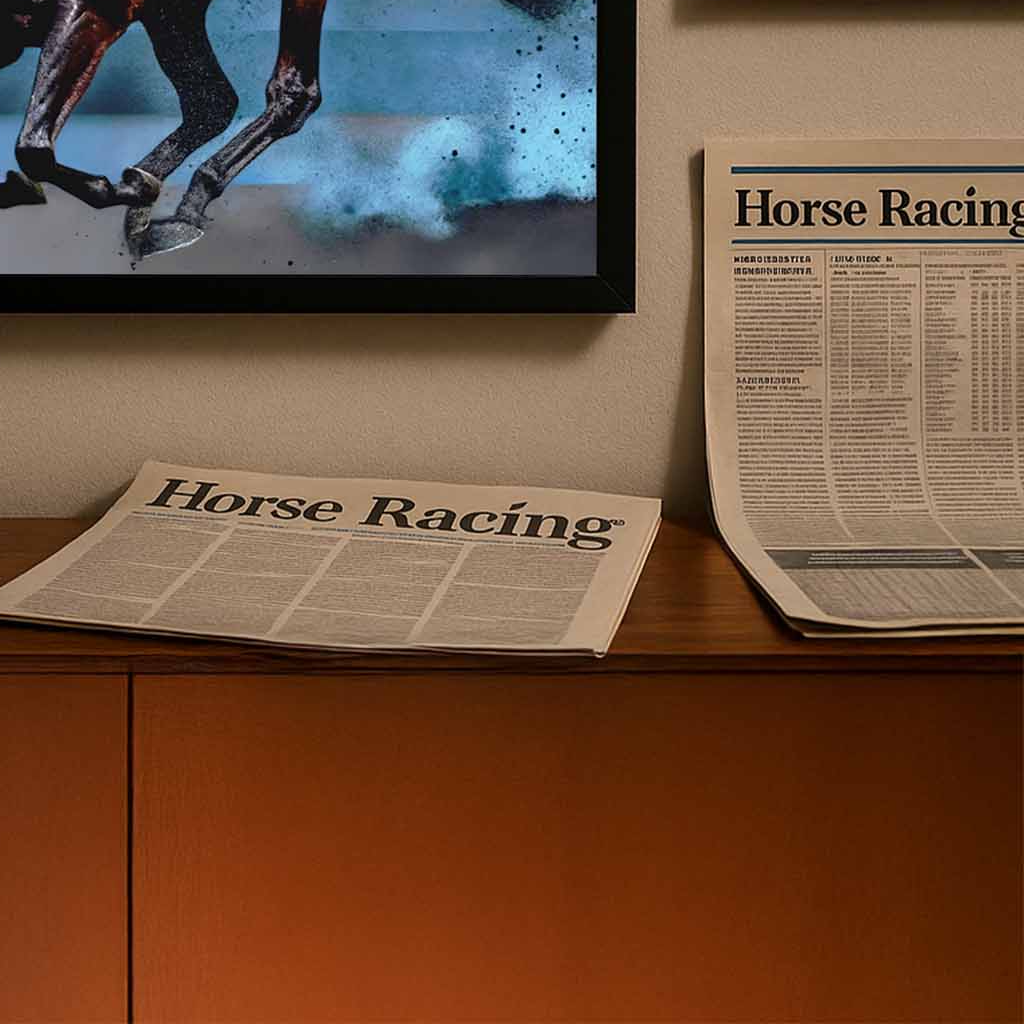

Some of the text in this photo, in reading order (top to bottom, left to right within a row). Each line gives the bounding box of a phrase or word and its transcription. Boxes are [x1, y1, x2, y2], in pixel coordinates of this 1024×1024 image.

[734, 189, 867, 227] Horse
[145, 478, 343, 522] Horse
[358, 495, 613, 551] Racing
